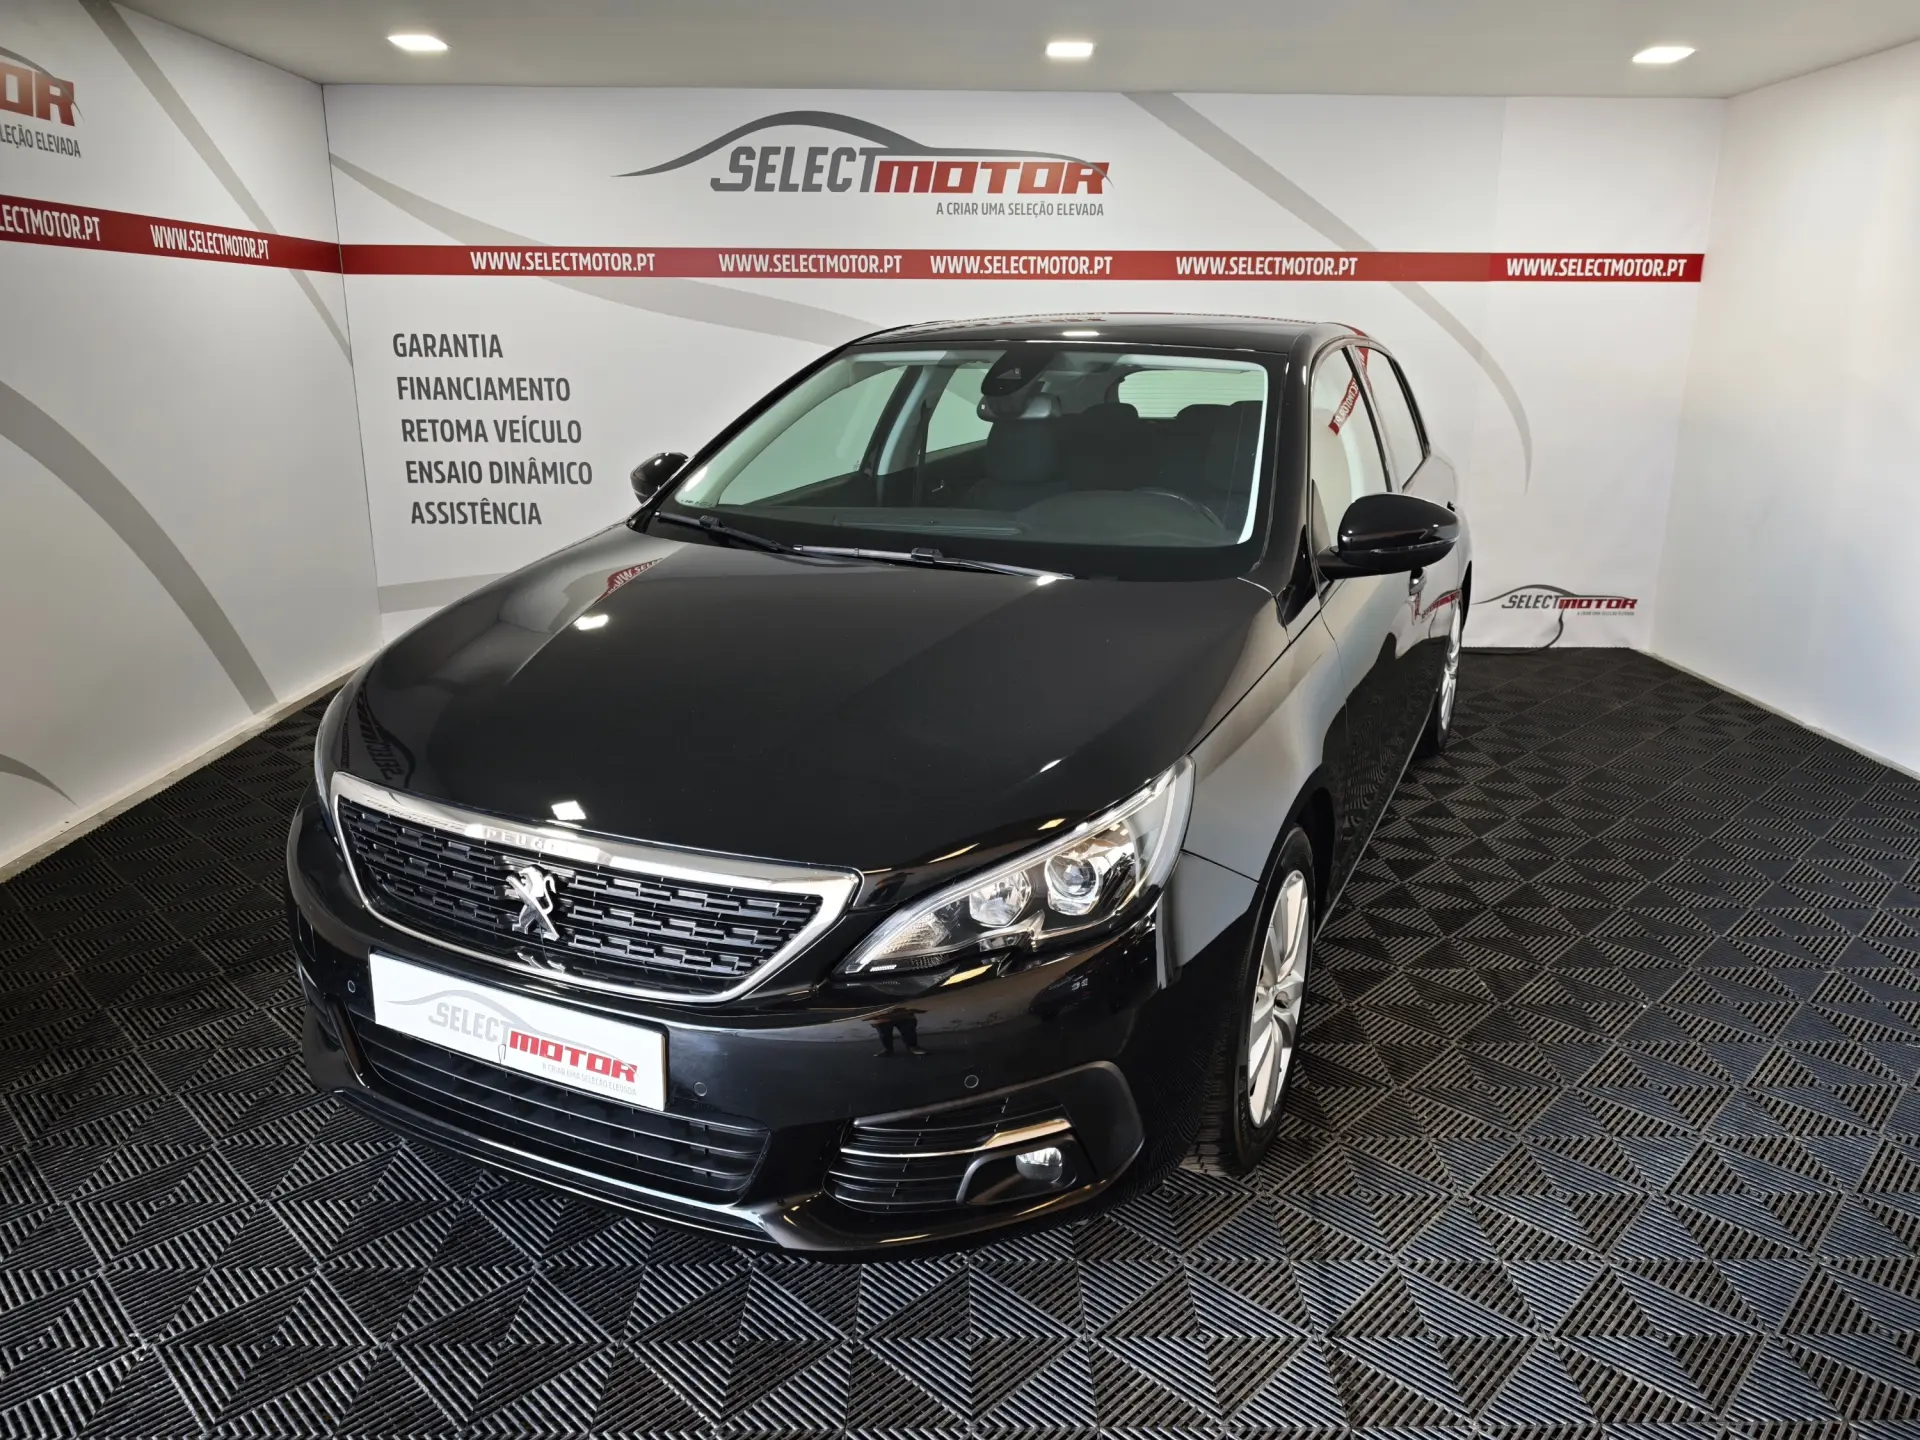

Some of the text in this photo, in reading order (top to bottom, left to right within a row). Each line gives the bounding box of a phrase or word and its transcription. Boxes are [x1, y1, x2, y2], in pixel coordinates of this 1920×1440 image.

[36, 132, 81, 158] ELEVADA
[936, 201, 1104, 218] A CRIAR UMA SELEÇÃO ELEVADA
[150, 225, 269, 260] WWW.SELECTMOTOR.PT
[470, 251, 1686, 277] WWW.SELECTMOTOR.PT WWW.SELECTMOTOR.PT WWW.SELECTMOTOR.PT WWW.SELECTMOTOR.PT WWW.SELECTMOTOR.PT
[393, 333, 503, 358] GARANTIA
[396, 377, 570, 402] FINANCIAMENTO
[402, 415, 582, 444] RETOMA VEÍCULO
[405, 456, 593, 485] ENSAIO DINÂMICO
[410, 497, 542, 525] ASSISTÊNCIA
[1501, 594, 1638, 610] SELECTMOTOR
